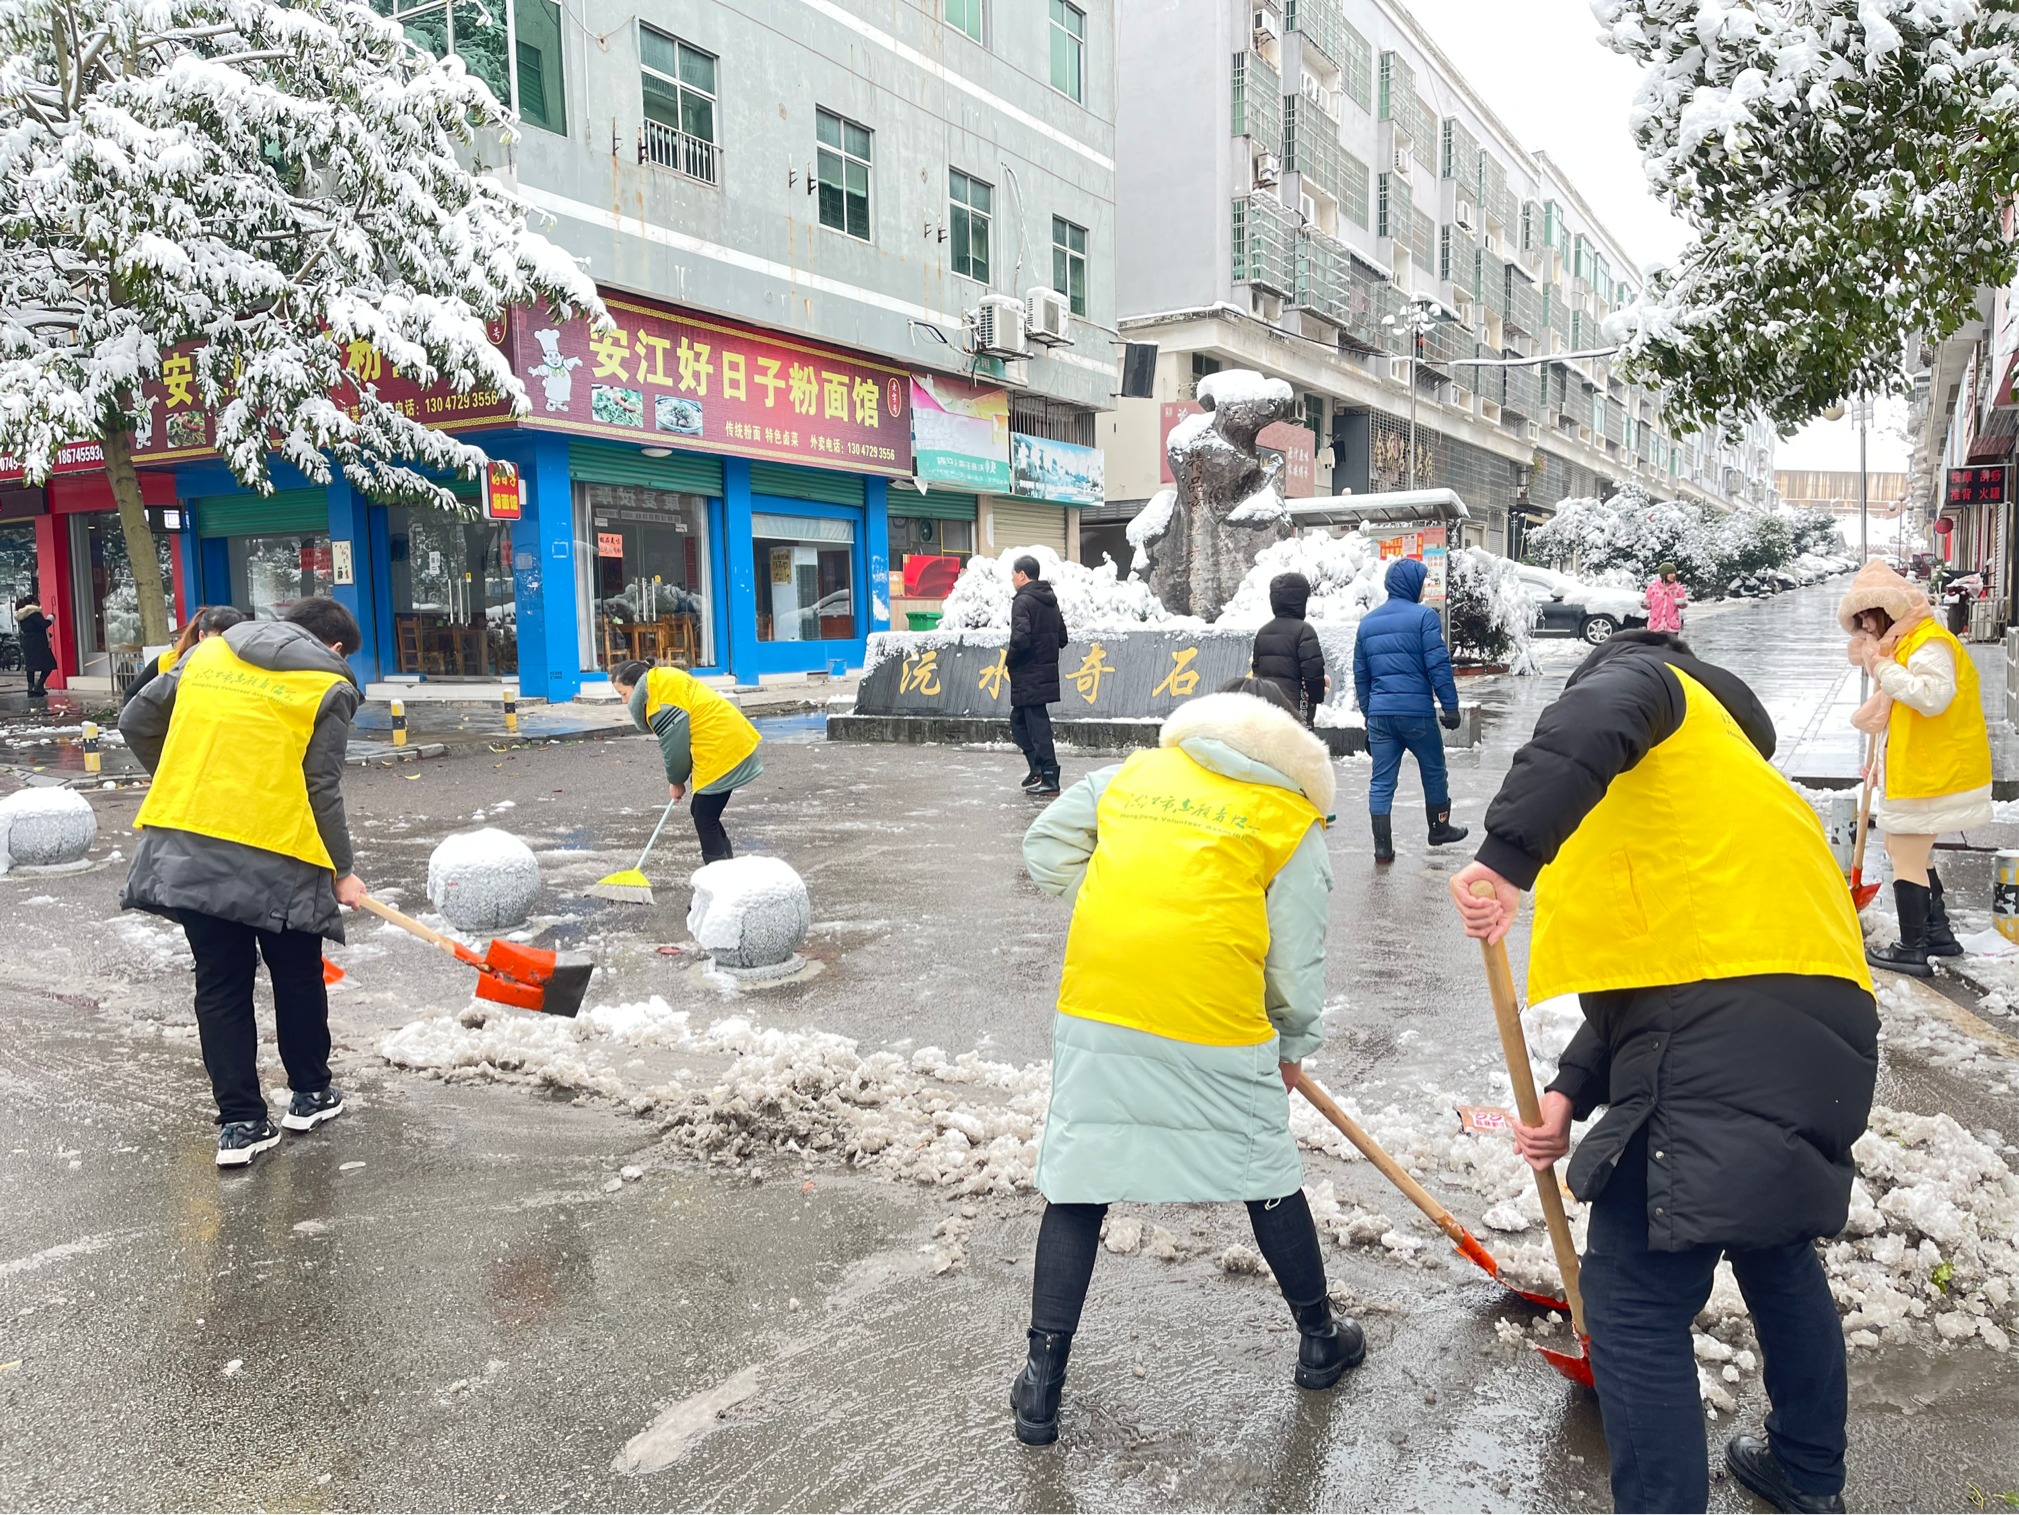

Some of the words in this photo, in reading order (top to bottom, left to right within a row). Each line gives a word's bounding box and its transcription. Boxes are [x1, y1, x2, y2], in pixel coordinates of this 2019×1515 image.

[589, 323, 880, 428] 安江好日子粉面馆
[425, 397, 444, 414] 130
[445, 392, 470, 411] 4729
[472, 390, 498, 408] 3556
[57, 444, 105, 465] 186745593
[725, 420, 761, 442] 传统粉面
[765, 427, 799, 447] 特色卤菜
[847, 442, 860, 456] 130
[861, 445, 878, 459] 4729
[879, 448, 895, 461] 3556
[900, 643, 1202, 705] 沅水奇石
[1161, 816, 1202, 828] Volunteer
